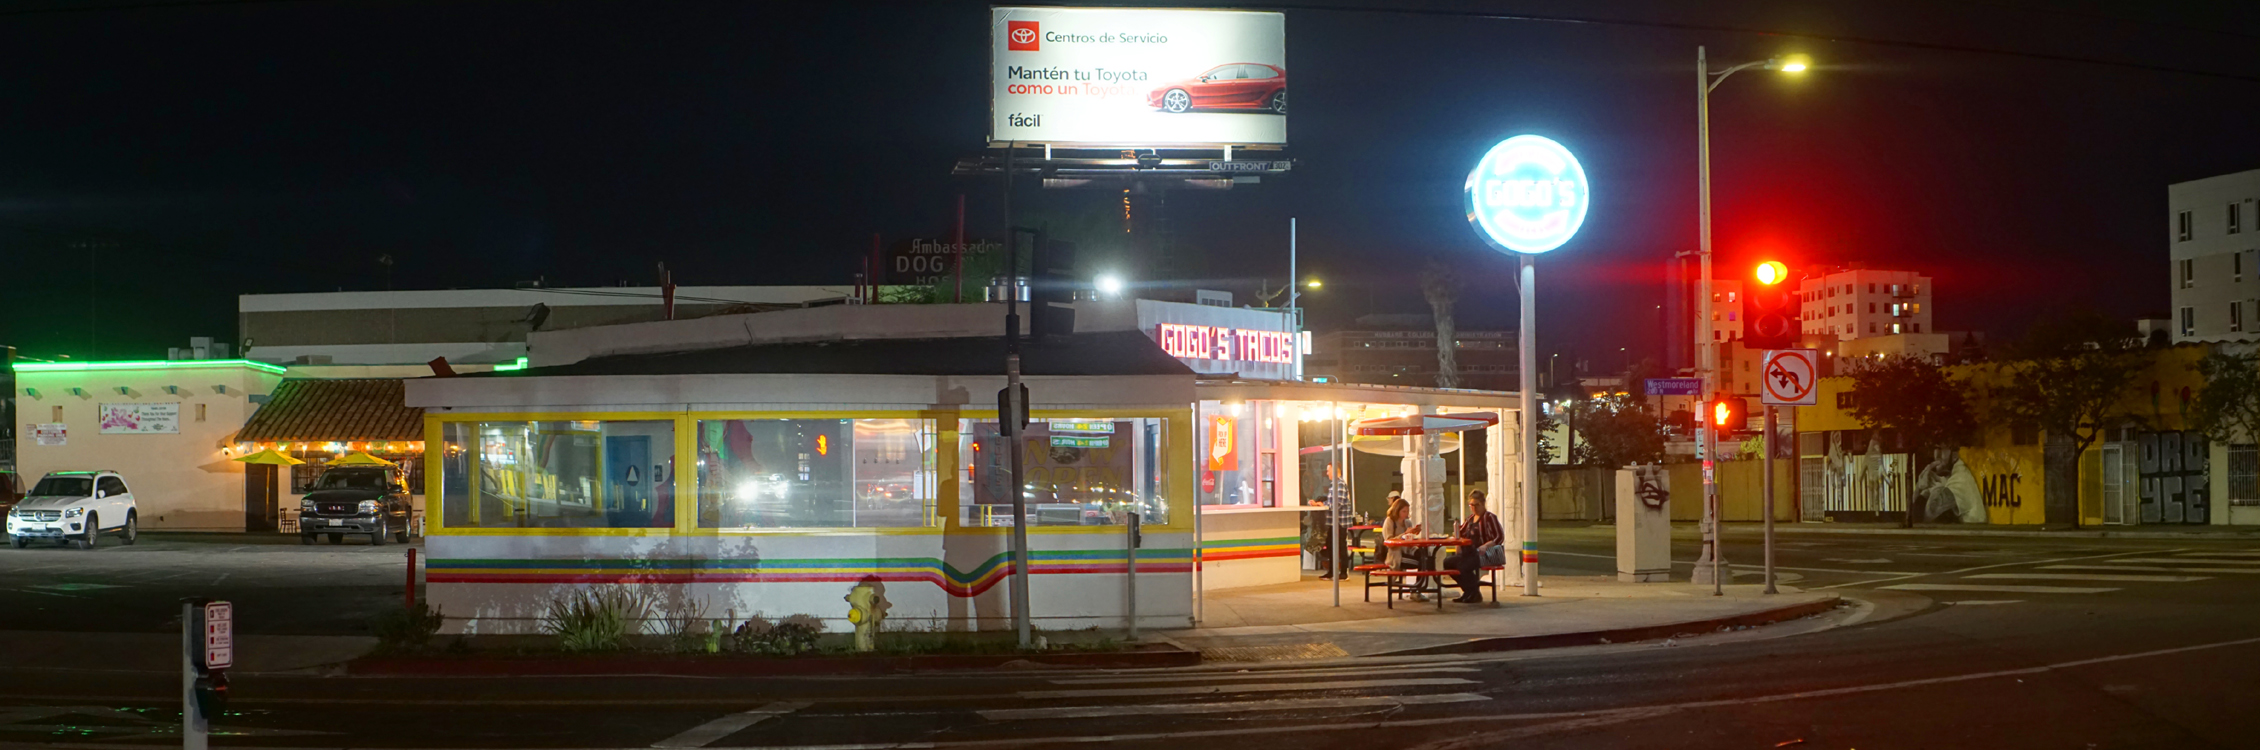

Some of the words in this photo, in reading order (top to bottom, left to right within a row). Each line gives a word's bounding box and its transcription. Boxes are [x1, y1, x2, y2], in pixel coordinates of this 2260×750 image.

[1045, 31, 1096, 43] Centros
[1099, 31, 1116, 43] de
[1119, 32, 1168, 44] Servicio
[1008, 65, 1069, 80] Mantén
[1073, 68, 1091, 81] tu
[1094, 67, 1148, 84] Toyota
[1007, 83, 1054, 95] como
[1057, 84, 1078, 95] un
[1008, 112, 1041, 127] fácil
[1211, 162, 1268, 171] OUTFRONT
[1486, 177, 1575, 206] GOGO'S
[896, 255, 944, 273] DOG
[1160, 322, 1230, 361] GOGO'S
[1236, 328, 1293, 364] TACOS
[1647, 380, 1699, 389] Westmoreland
[1022, 466, 1124, 493] OPEN
[1982, 473, 2022, 508] MAC
